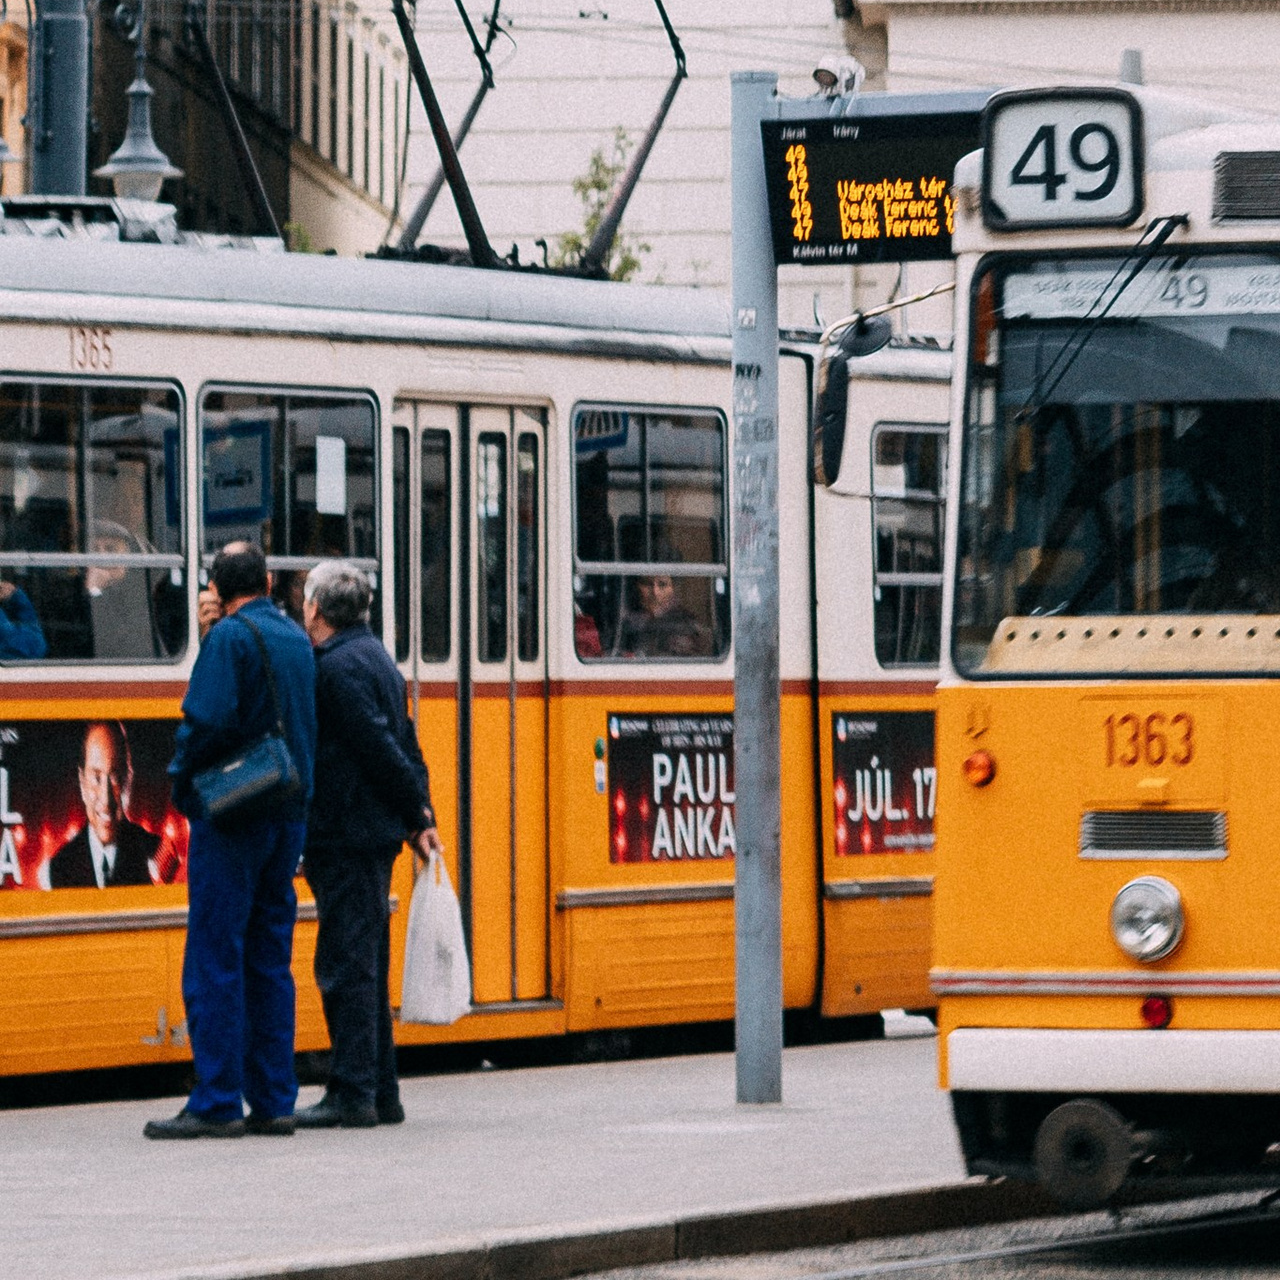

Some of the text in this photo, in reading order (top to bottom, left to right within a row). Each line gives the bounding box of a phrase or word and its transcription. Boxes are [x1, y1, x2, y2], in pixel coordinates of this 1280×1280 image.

[785, 144, 806, 164] 49
[1010, 122, 1120, 201] 49
[790, 182, 809, 203] 47
[920, 176, 946, 198] tér
[884, 197, 938, 219] Ferenc
[793, 219, 813, 241] 47
[885, 216, 940, 238] Ferenc
[1160, 275, 1208, 308] 49
[1102, 711, 1195, 768] 1363
[652, 752, 736, 805] PAUL
[912, 767, 937, 820] 17
[652, 805, 737, 858] ANKA
